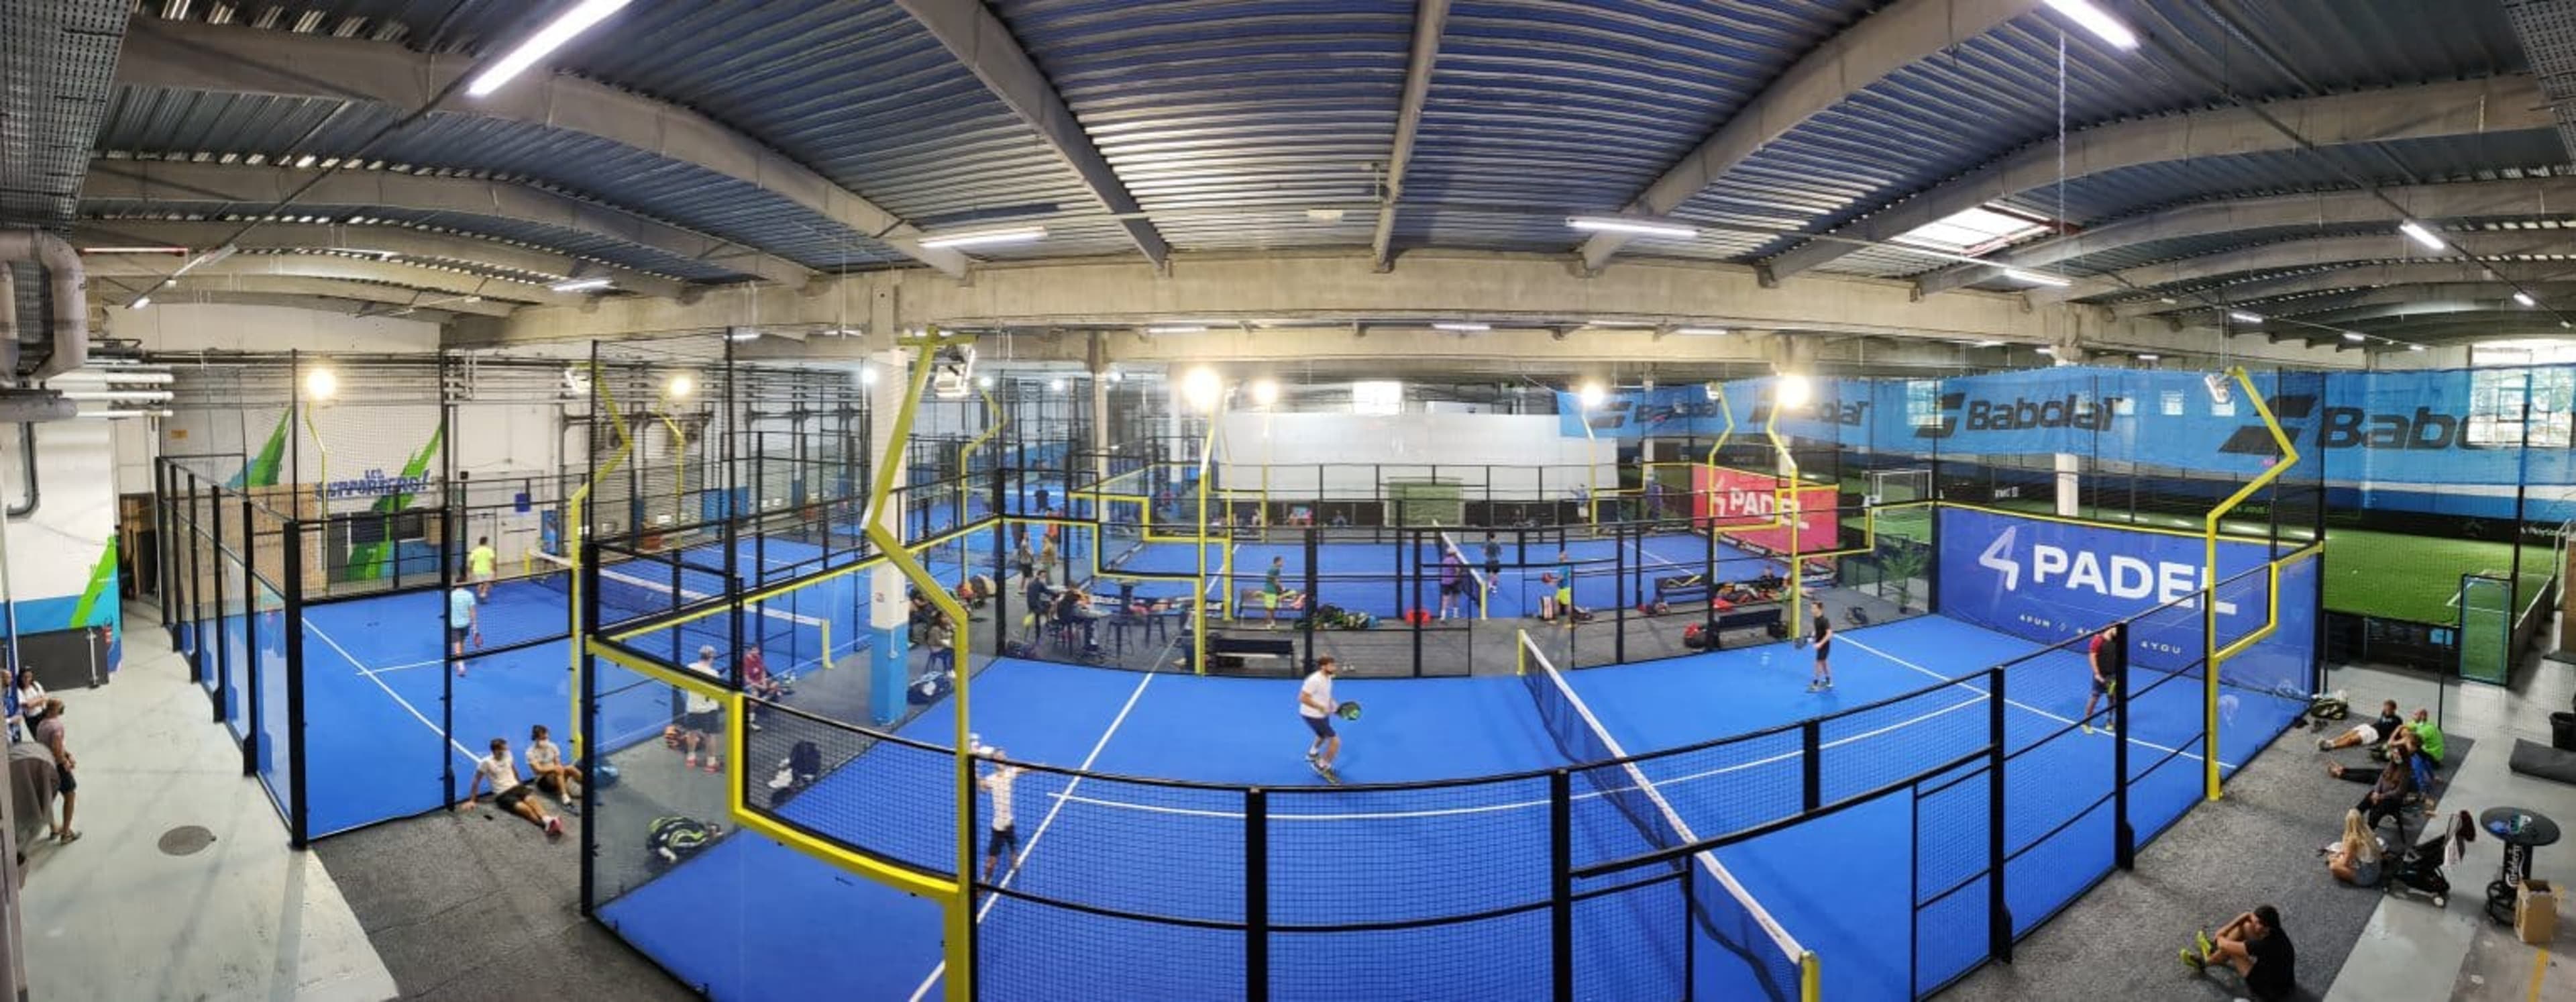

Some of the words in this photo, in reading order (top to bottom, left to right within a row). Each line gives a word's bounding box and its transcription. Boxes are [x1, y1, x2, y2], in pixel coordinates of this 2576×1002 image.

[1966, 395, 2123, 432] Babolat
[1729, 487, 1810, 530] PADEL
[2033, 544, 2237, 615] PADEL
